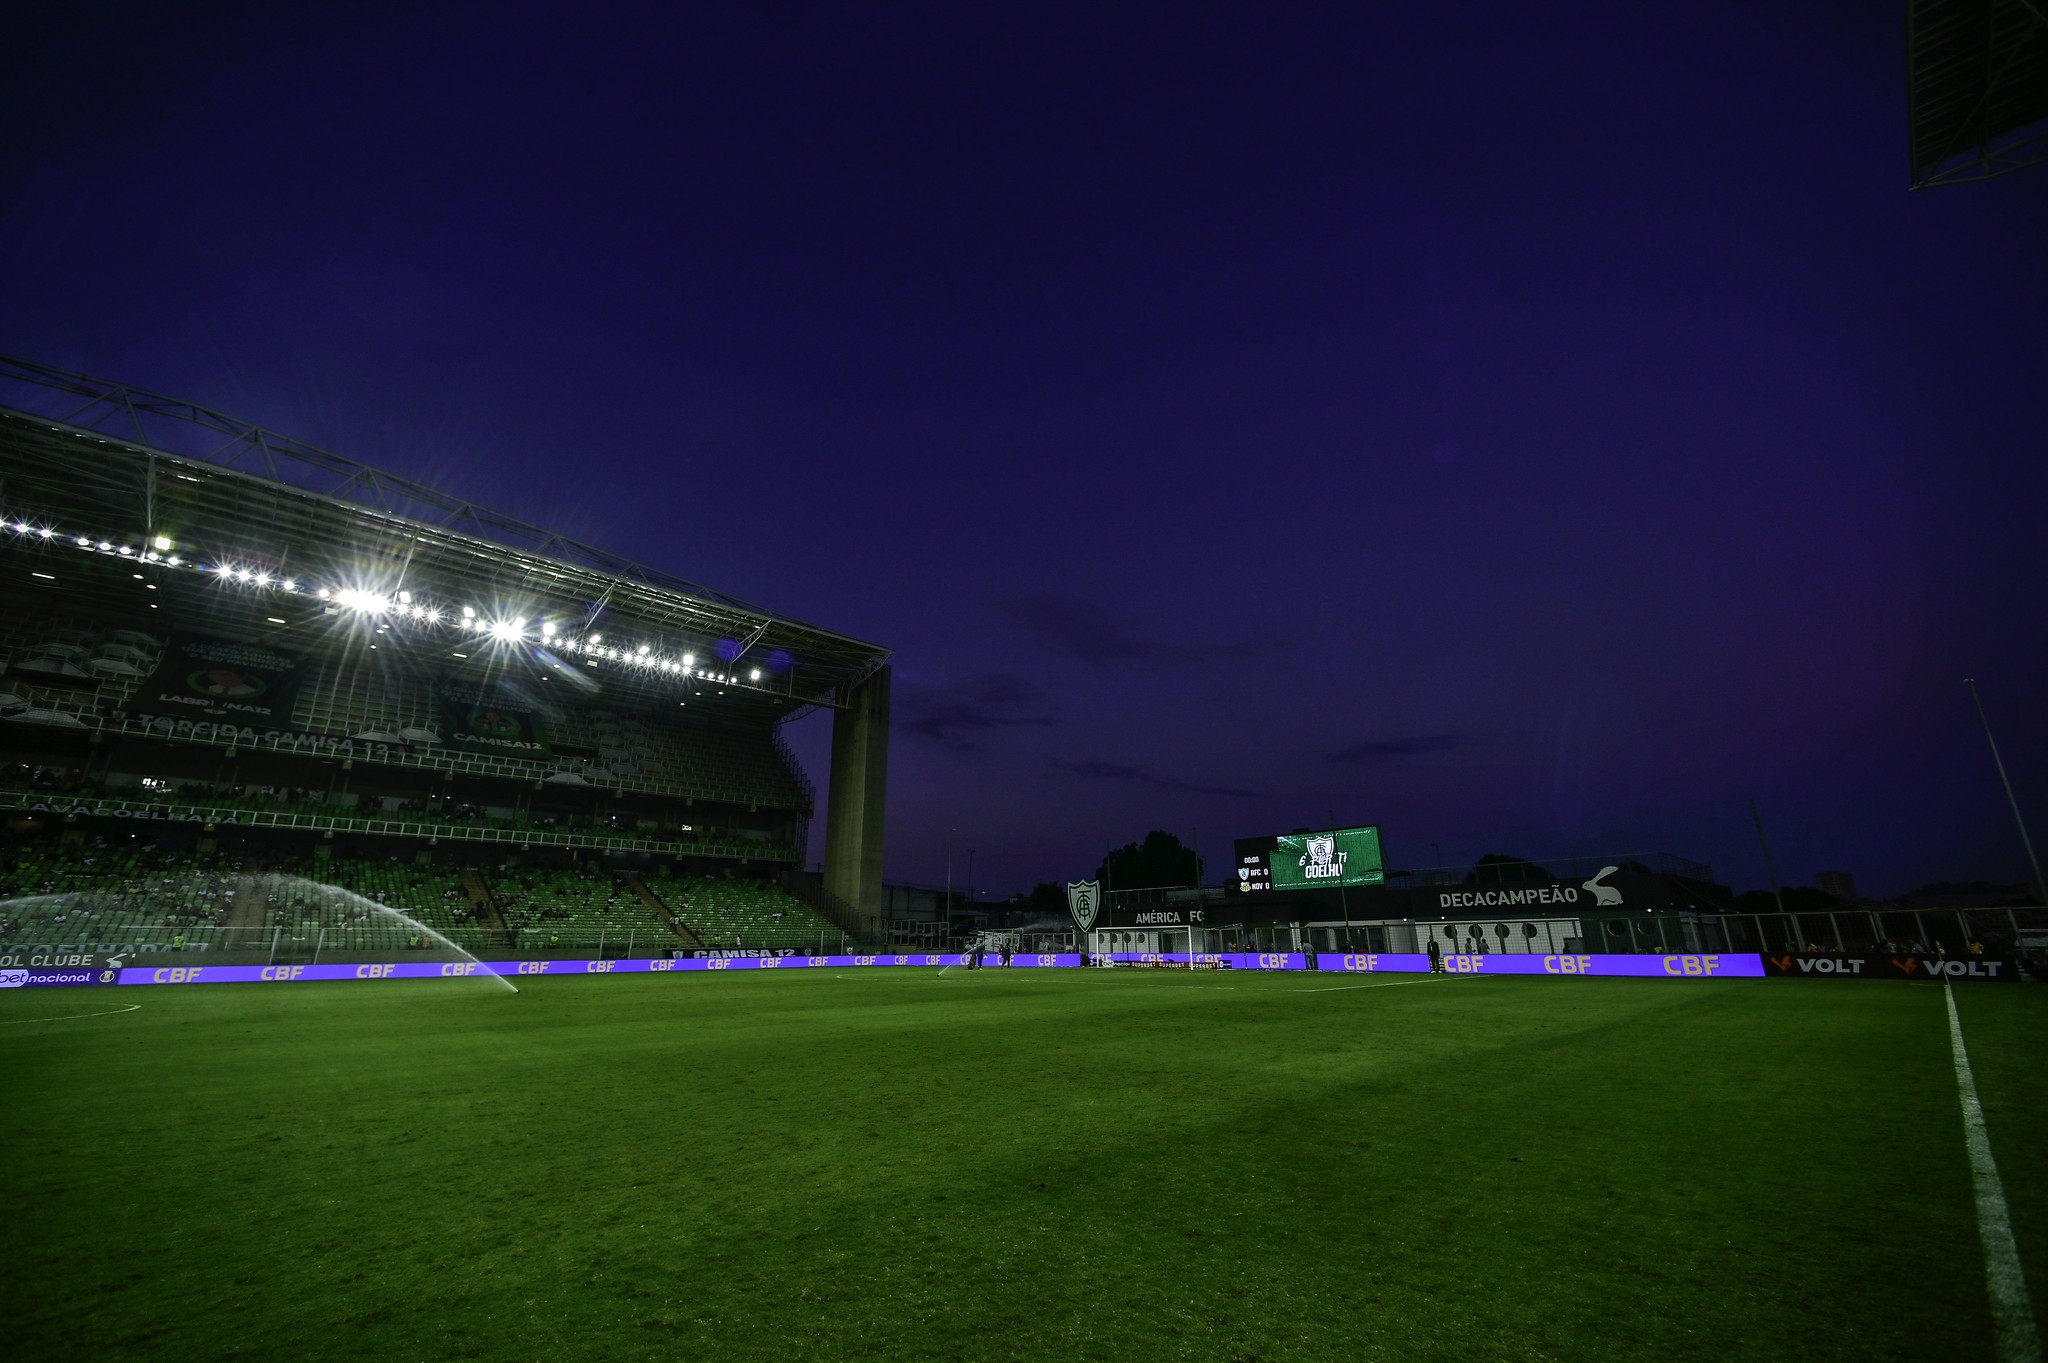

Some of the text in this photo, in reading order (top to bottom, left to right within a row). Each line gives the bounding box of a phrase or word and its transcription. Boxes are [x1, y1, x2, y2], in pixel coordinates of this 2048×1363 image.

[138, 714, 389, 755] TORCIDA CAMISA 12
[30, 803, 240, 825] AVACOELHADA
[1440, 884, 1578, 908] DECACAMPEÃO
[1135, 909, 1205, 924] AMÉRICA FC
[30, 954, 94, 967] CLUBE
[693, 949, 796, 959] CAMISA 12
[855, 956, 877, 966] CBF
[895, 956, 908, 966] CBF
[926, 955, 941, 966] CBF
[1038, 955, 1057, 967] CBF
[1259, 954, 1288, 968] CBF
[518, 962, 550, 974] CBF
[587, 961, 616, 973] CBF
[650, 960, 676, 971] CBF
[707, 959, 731, 969] CBF
[760, 958, 782, 968] CBF
[808, 957, 828, 967] CBF
[1343, 955, 1378, 971] CBF
[1443, 955, 1484, 973] CBF
[1544, 956, 1591, 974] CBF
[1663, 956, 1720, 975] CBF
[1797, 958, 2003, 977] VOLT VOLT
[153, 968, 203, 983] CBF
[261, 966, 305, 981] CBF
[356, 965, 395, 979] CBF
[441, 963, 477, 977] CBF
